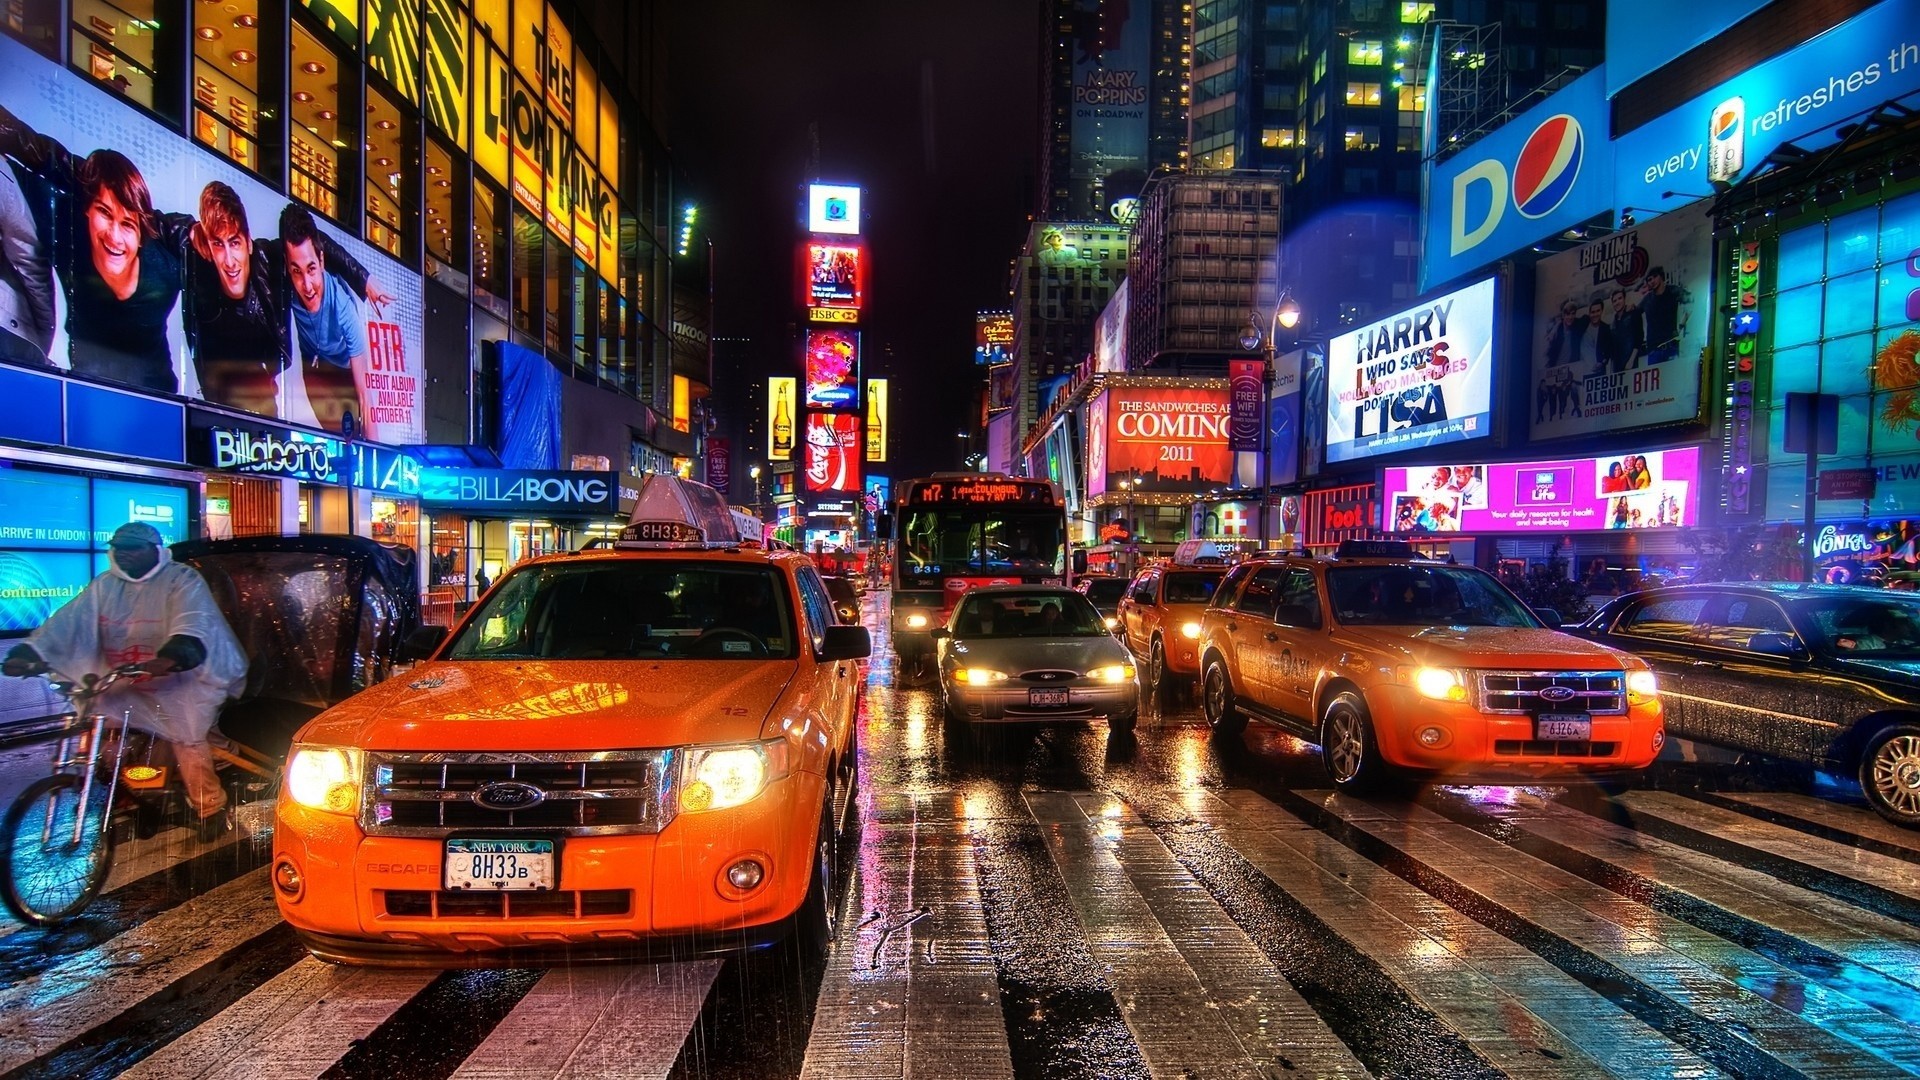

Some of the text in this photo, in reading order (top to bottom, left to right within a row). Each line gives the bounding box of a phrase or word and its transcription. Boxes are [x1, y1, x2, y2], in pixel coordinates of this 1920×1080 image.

[532, 22, 571, 108] THE
[1087, 71, 1137, 88] MARY
[1075, 86, 1146, 105] POPPINS
[1076, 109, 1144, 119] ON BROADWAY
[1644, 141, 1703, 184] every
[1751, 59, 1881, 137] refreshes
[485, 21, 612, 240] LION KING
[515, 180, 542, 213] ENTRANCE
[1581, 231, 1638, 268] BIG TIME
[1598, 253, 1632, 281] RUSH
[1741, 241, 1759, 308] TOYS
[811, 309, 841, 320] HSBC
[1356, 299, 1454, 365] HARRY
[367, 321, 406, 373] BTR
[1738, 339, 1755, 372] US
[1366, 347, 1434, 381] WHO SAYS
[365, 373, 416, 393] DEBUT ALBUM
[1338, 380, 1397, 404] HOLLYWOOD
[1400, 358, 1468, 388] MARRIAGES
[1586, 368, 1660, 395] DEBUT BTR
[378, 390, 415, 408] AVAILABLE
[1235, 391, 1258, 401] FREE
[1585, 385, 1629, 406] ALBUM
[1118, 401, 1143, 412] THE
[1144, 401, 1218, 414] SANDWICHES
[1237, 401, 1256, 411] WIFI
[1354, 384, 1448, 439] LISA
[1584, 401, 1633, 418] OCTOBER 11
[370, 407, 412, 423] OCTOBER 11
[1368, 439, 1384, 447] HARRY
[1384, 436, 1398, 444] LOVES
[1411, 428, 1441, 440] Wednesdays
[1159, 445, 1194, 462] 2011
[1837, 472, 1872, 481] STOPPING
[461, 476, 608, 503] BILLABONG
[923, 484, 941, 501] M7
[975, 485, 1016, 494] COLUMBUS
[1531, 489, 1556, 501] Life
[1325, 504, 1363, 529] Foot
[1491, 510, 1507, 519] Your
[1509, 509, 1528, 520] daily
[1561, 508, 1571, 517] for
[1573, 507, 1595, 517] health
[1532, 518, 1569, 527] well-being
[0, 526, 33, 540] ARRIVE
[35, 528, 46, 540] IN
[48, 529, 86, 541] LONDON
[642, 524, 680, 539] 8H33
[721, 707, 749, 717] 72
[490, 789, 525, 803] Ford
[473, 842, 528, 853] NEW YORK
[366, 863, 440, 875] ESCAPE
